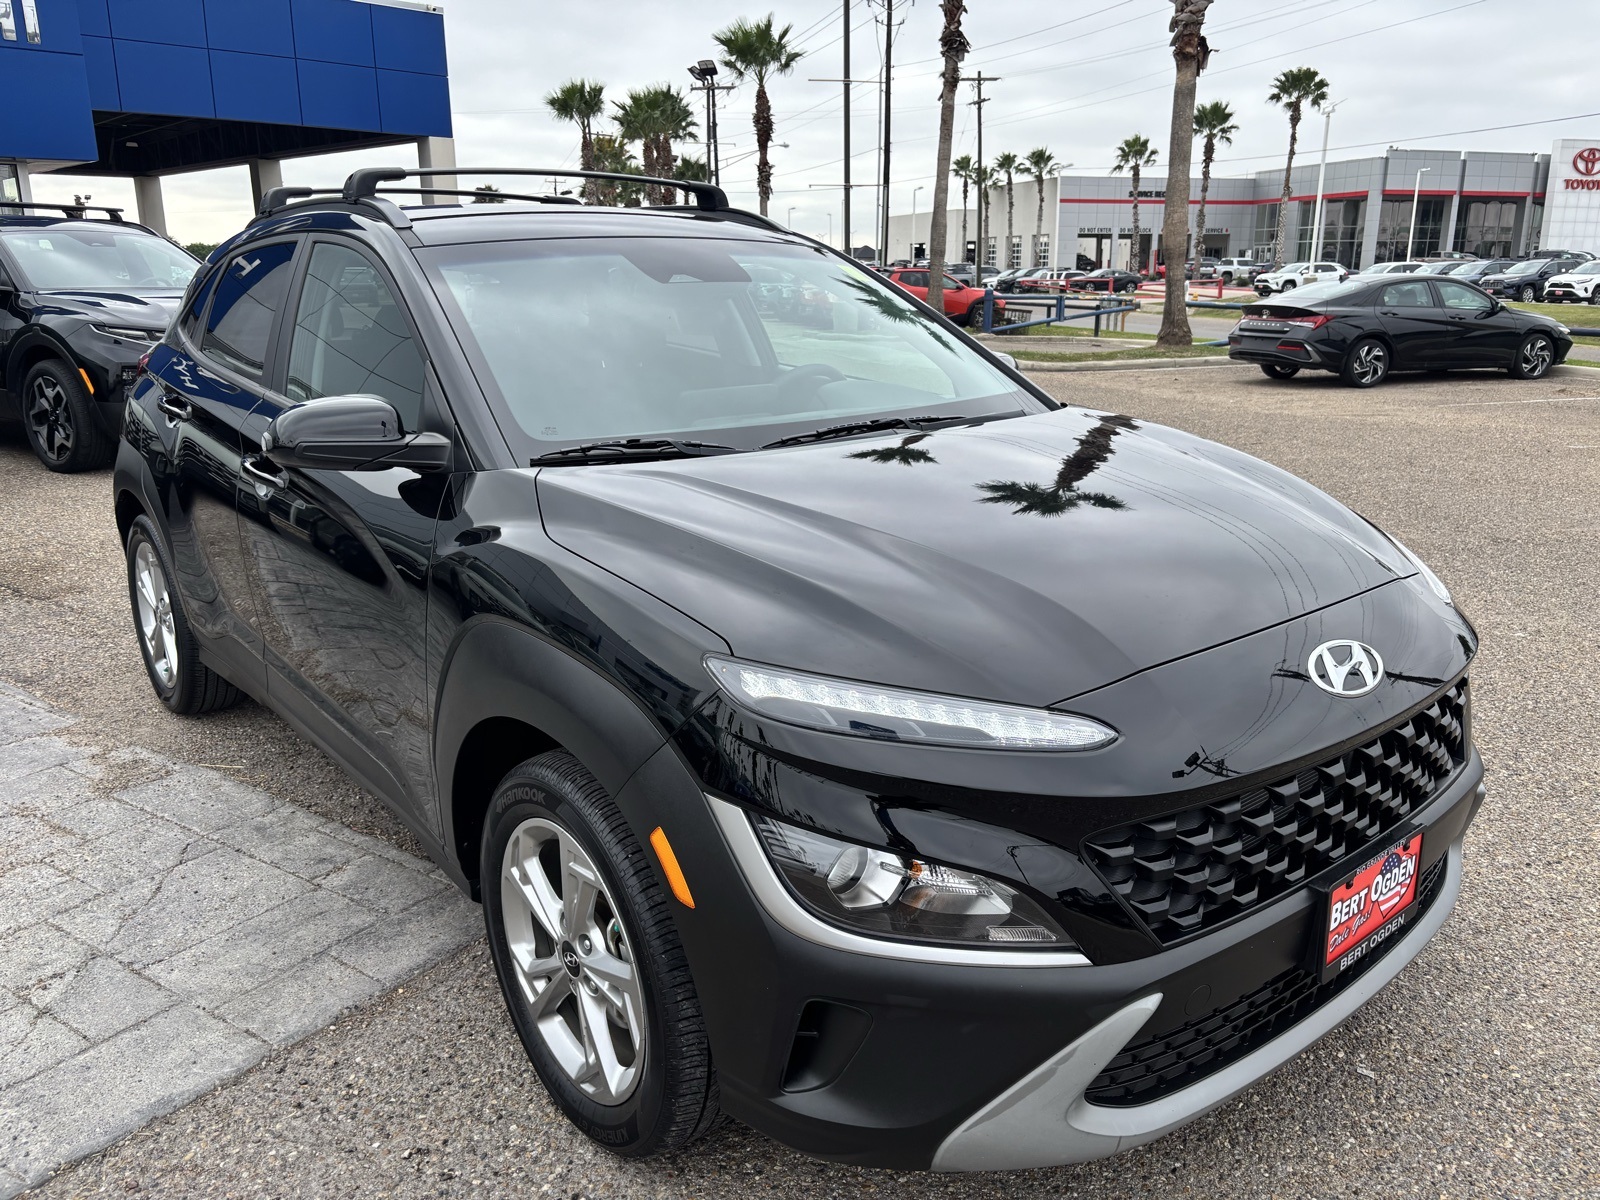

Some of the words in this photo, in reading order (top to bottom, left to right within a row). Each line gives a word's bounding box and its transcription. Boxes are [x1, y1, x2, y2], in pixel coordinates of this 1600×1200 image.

[1128, 190, 1154, 198] SRVICE
[1329, 887, 1369, 932] BERT
[1370, 855, 1416, 902] OGDEN
[1340, 940, 1369, 971] BERT
[1369, 913, 1406, 948] OGDEN
